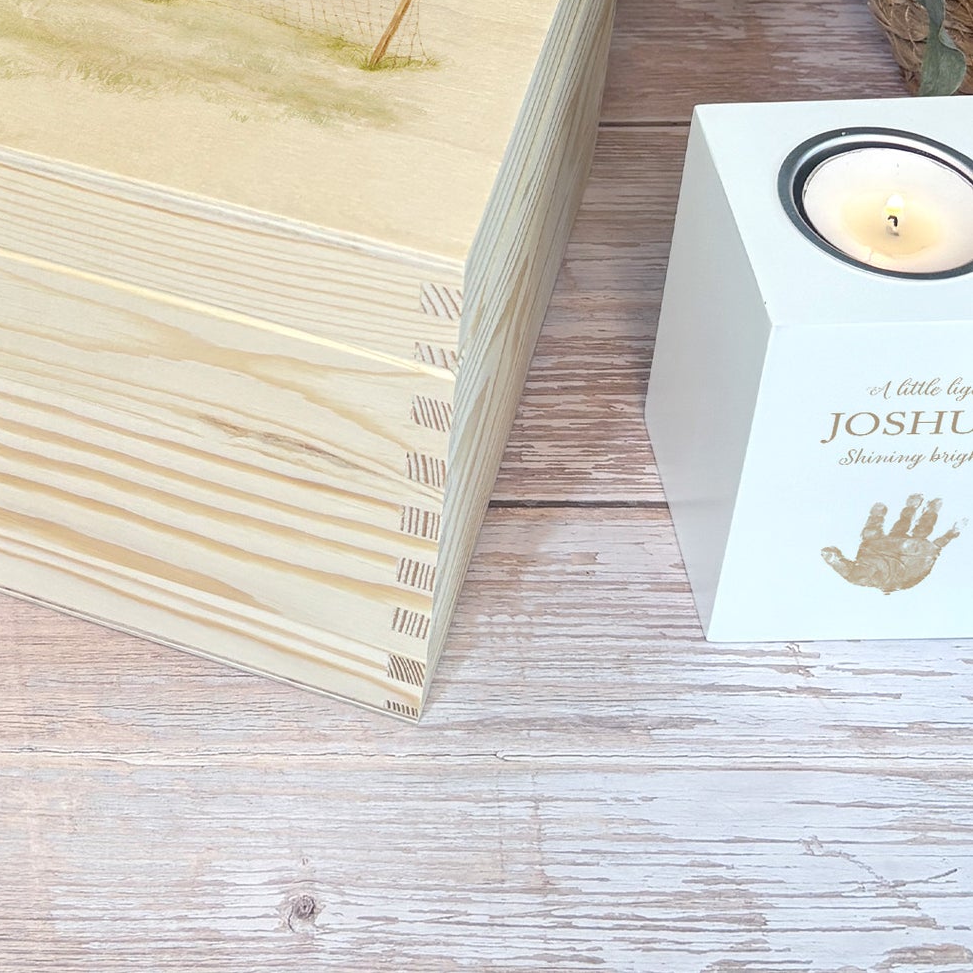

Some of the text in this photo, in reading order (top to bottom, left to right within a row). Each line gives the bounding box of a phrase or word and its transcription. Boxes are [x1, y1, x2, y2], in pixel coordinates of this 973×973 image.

[867, 377, 973, 402] A little lig
[820, 409, 973, 444] JOSHU
[838, 448, 926, 470] Shining
